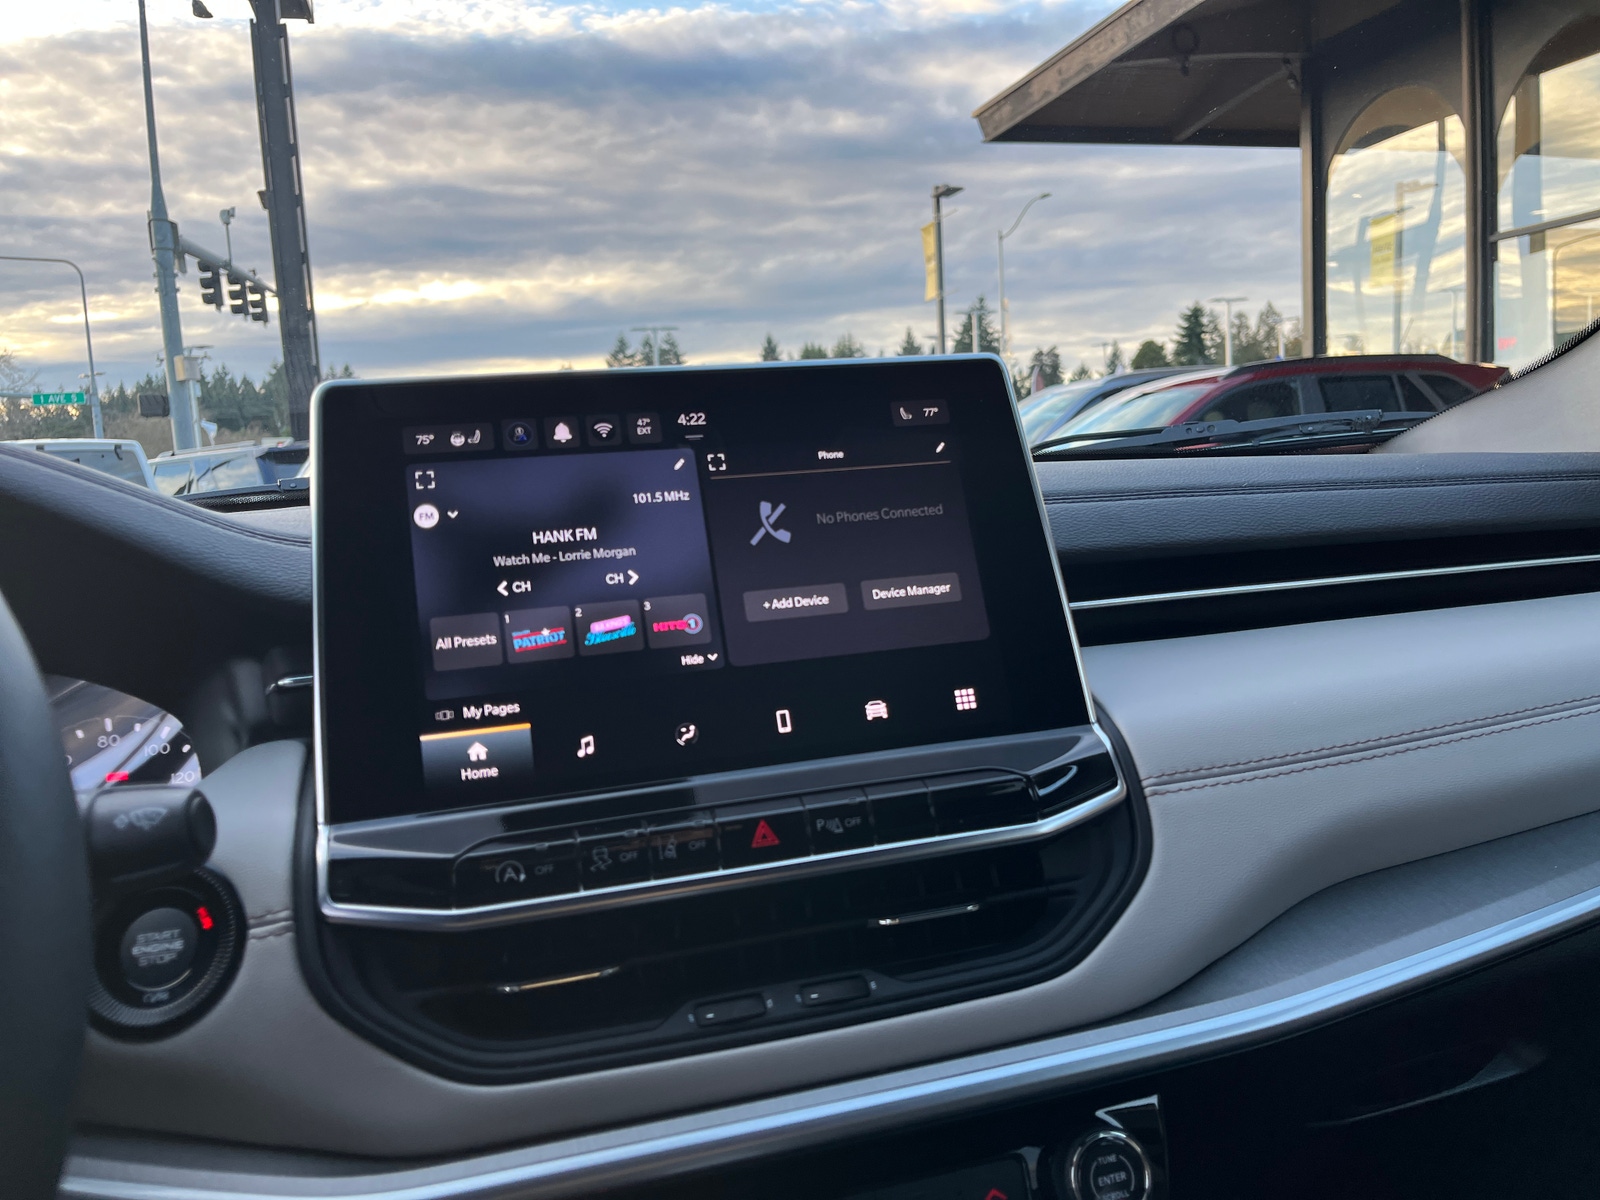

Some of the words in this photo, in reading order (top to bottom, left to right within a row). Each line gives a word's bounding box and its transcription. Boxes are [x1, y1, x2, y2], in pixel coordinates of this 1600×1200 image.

[48, 394, 66, 404] AVE
[677, 412, 707, 426] 4:22
[636, 427, 651, 436] EXT
[817, 450, 844, 460] Phone
[633, 491, 662, 504] 101.5
[664, 490, 690, 503] MHz
[418, 512, 436, 521] FM
[816, 513, 834, 525] No
[836, 510, 879, 524] Phones
[881, 504, 944, 520] Connected
[532, 528, 574, 545] HANK
[576, 526, 598, 542] FM
[493, 553, 530, 568] Watch
[532, 552, 551, 565] Me
[558, 548, 592, 562] Lorrie
[593, 546, 637, 562] Morgan
[605, 573, 624, 585] CH
[512, 581, 532, 593] CH
[872, 586, 906, 601] Device
[907, 583, 951, 599] Manager
[643, 600, 651, 611] 3
[771, 597, 796, 611] Add
[796, 594, 830, 608] Device
[504, 614, 510, 624] 1
[575, 608, 583, 618] 2
[435, 636, 453, 651] All
[454, 632, 497, 649] Presets
[513, 630, 565, 650] PATRIOT
[681, 653, 705, 666] Hide
[462, 706, 482, 720] My
[484, 702, 521, 718] Pages
[97, 734, 121, 748] 80
[144, 742, 170, 758] 100
[171, 771, 196, 785] 120
[460, 766, 499, 781] Home
[137, 929, 181, 944] START
[1098, 1154, 1117, 1165] TUNE
[1098, 1171, 1127, 1187] ENTER
